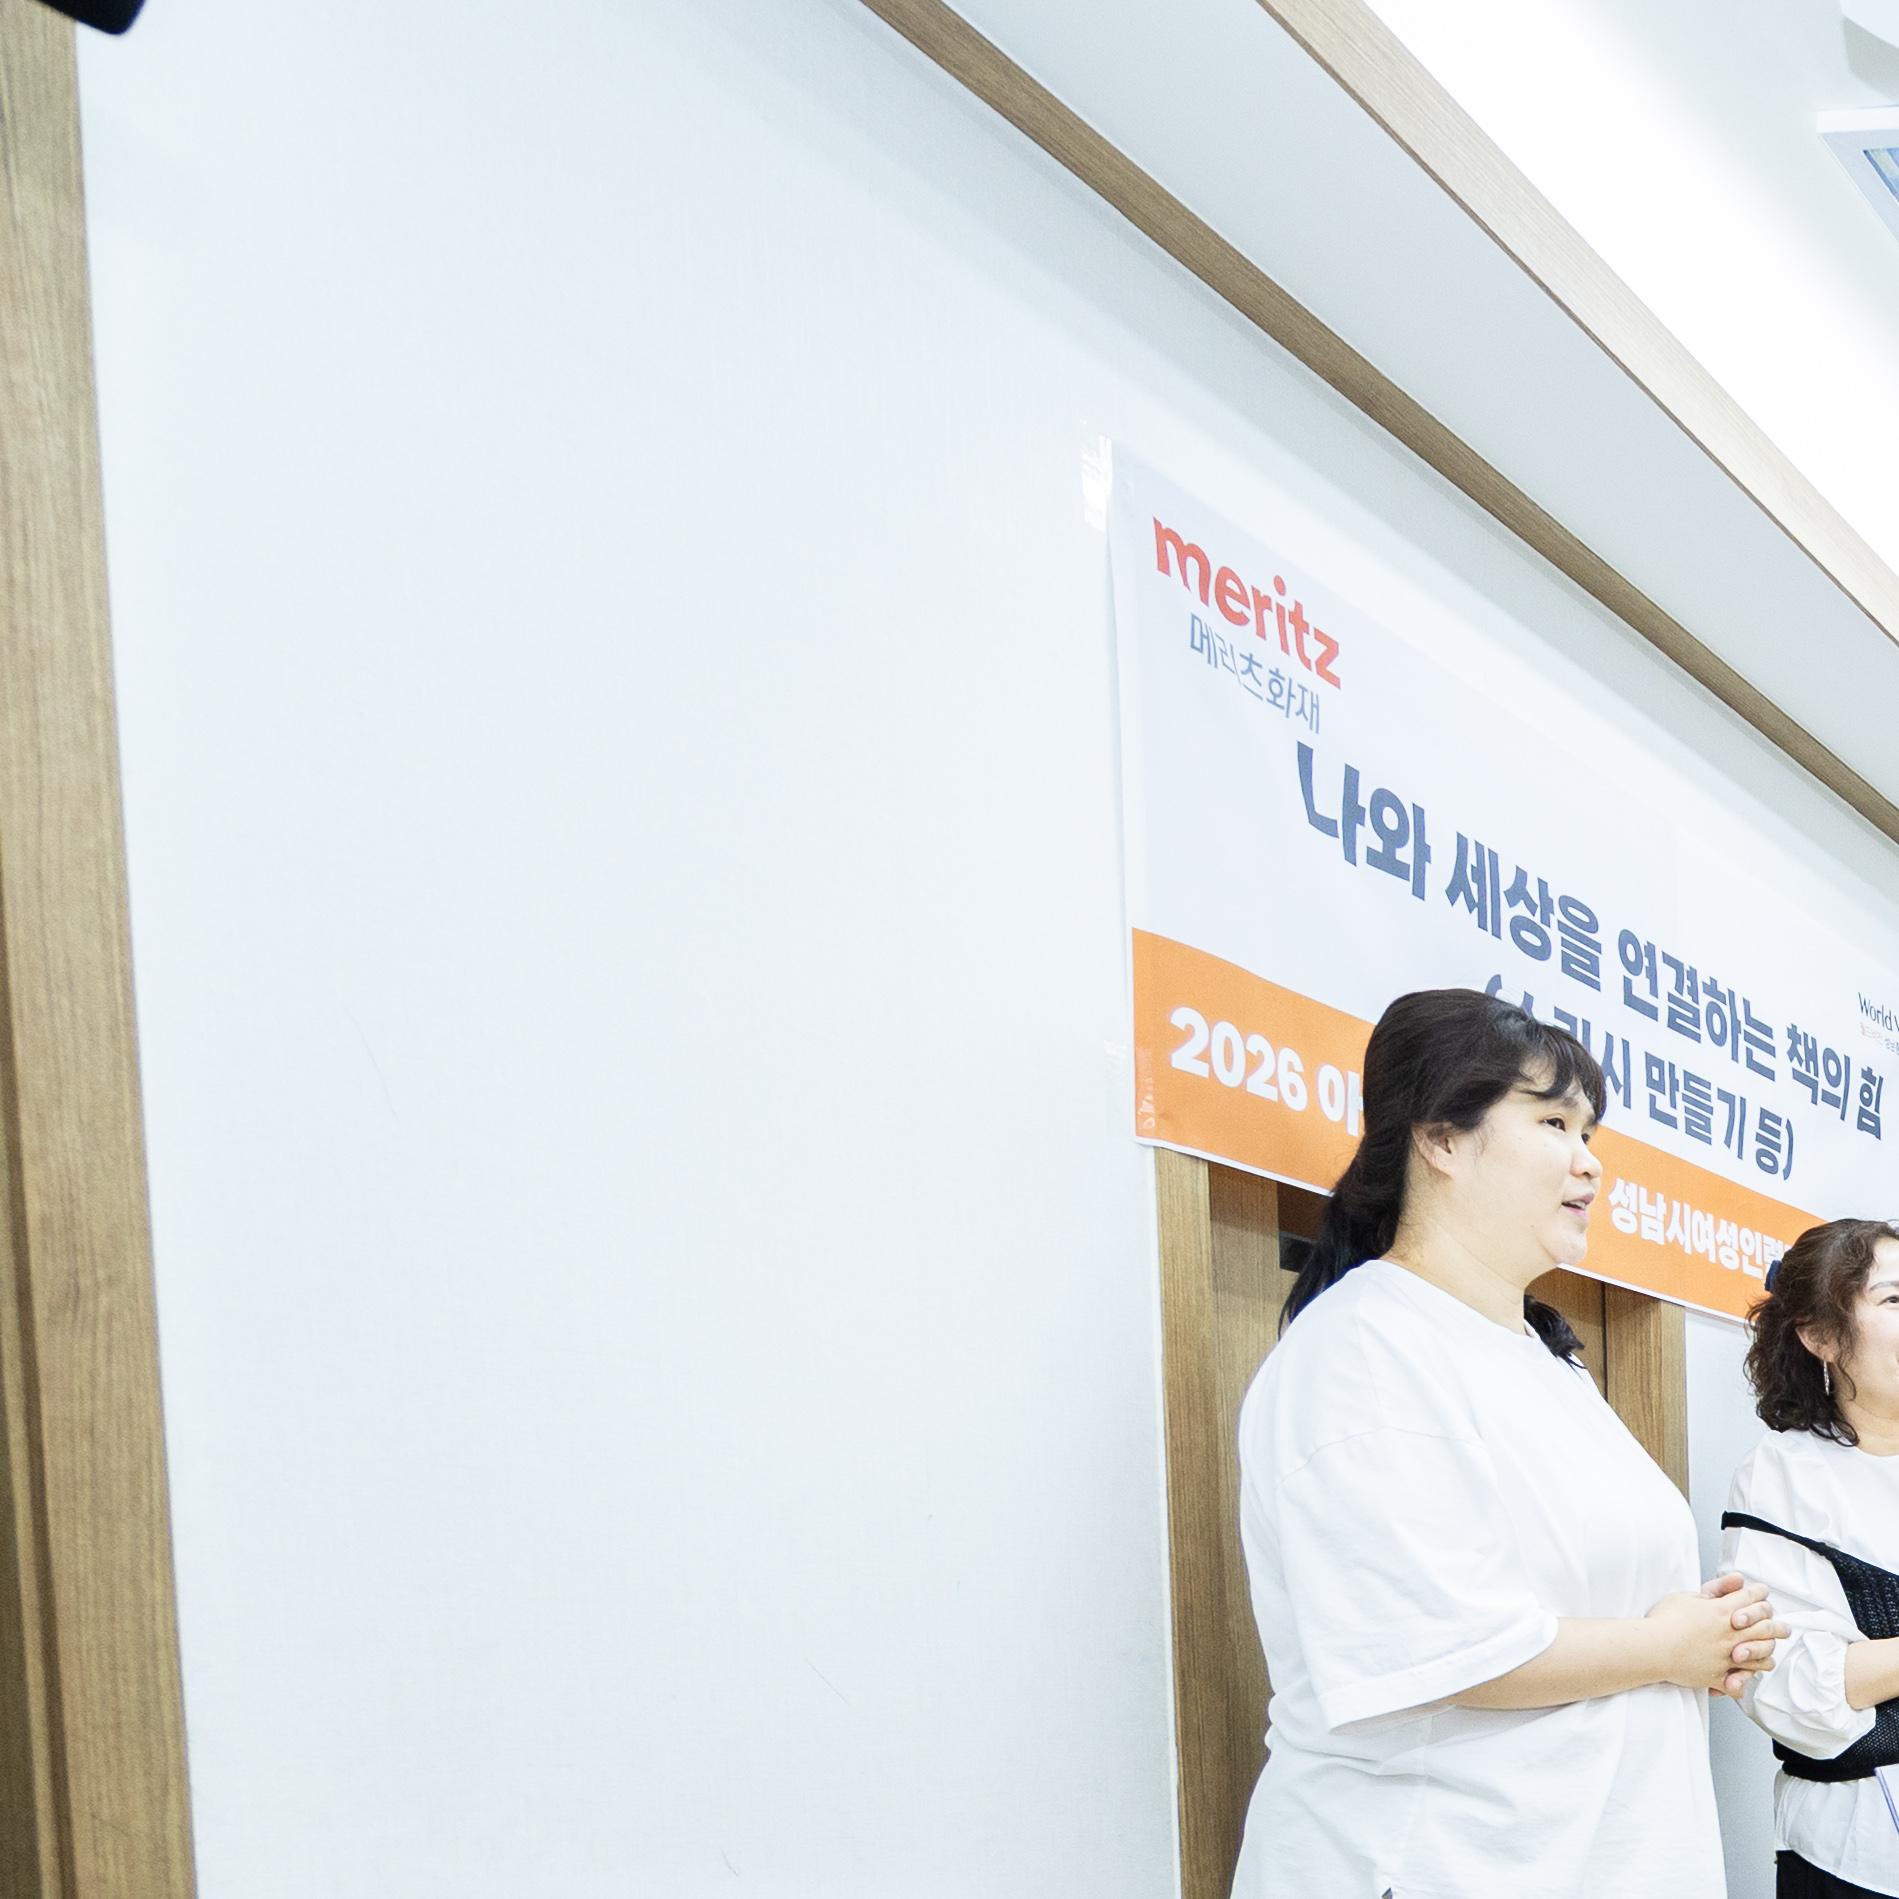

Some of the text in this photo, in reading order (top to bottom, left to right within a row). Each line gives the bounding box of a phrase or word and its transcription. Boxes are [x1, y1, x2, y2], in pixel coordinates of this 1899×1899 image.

[1154, 517, 1341, 689] meritz
[1190, 611, 1320, 734] 메리츠화재
[1297, 740, 1430, 900] 나와
[1446, 832, 1602, 992] 세상을
[1618, 927, 1777, 1078] 연결하는
[1788, 1034, 1850, 1121] 책의
[1857, 1063, 1884, 1139] 힘
[1168, 1005, 1308, 1112] 2026
[1858, 991, 1893, 1031] World
[1645, 1050, 1793, 1181] 만들기 등)
[1607, 1177, 1795, 1280] 성남시여성인력
